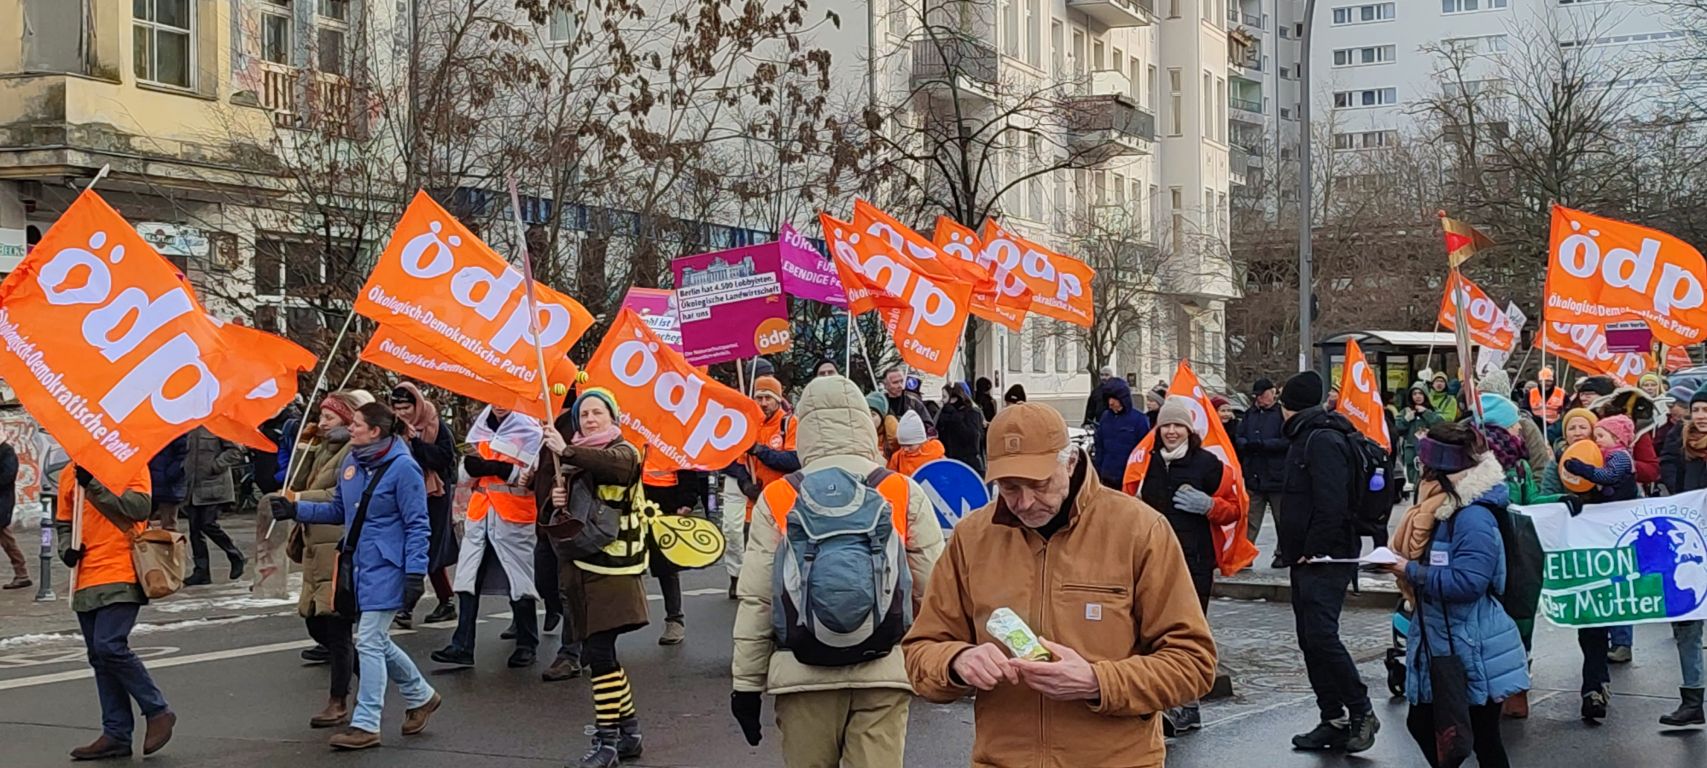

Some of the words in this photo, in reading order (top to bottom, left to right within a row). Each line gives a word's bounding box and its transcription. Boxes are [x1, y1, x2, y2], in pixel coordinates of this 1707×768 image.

[783, 260, 830, 286] EBENDIGE
[1558, 220, 1704, 316] ödp
[400, 220, 571, 354] ödp
[680, 287, 701, 298] Berlin
[701, 286, 714, 294] hat
[725, 284, 780, 301] Landwirtschaft
[37, 231, 220, 425] ödp
[368, 285, 500, 367] Ökologisch-Demokratische
[500, 358, 538, 383] Partei
[758, 328, 790, 349] ödp
[1669, 319, 1700, 339] Partei
[610, 326, 748, 459] ödp
[1544, 548, 1634, 580] ELLION
[1575, 576, 1663, 619] Mütter
